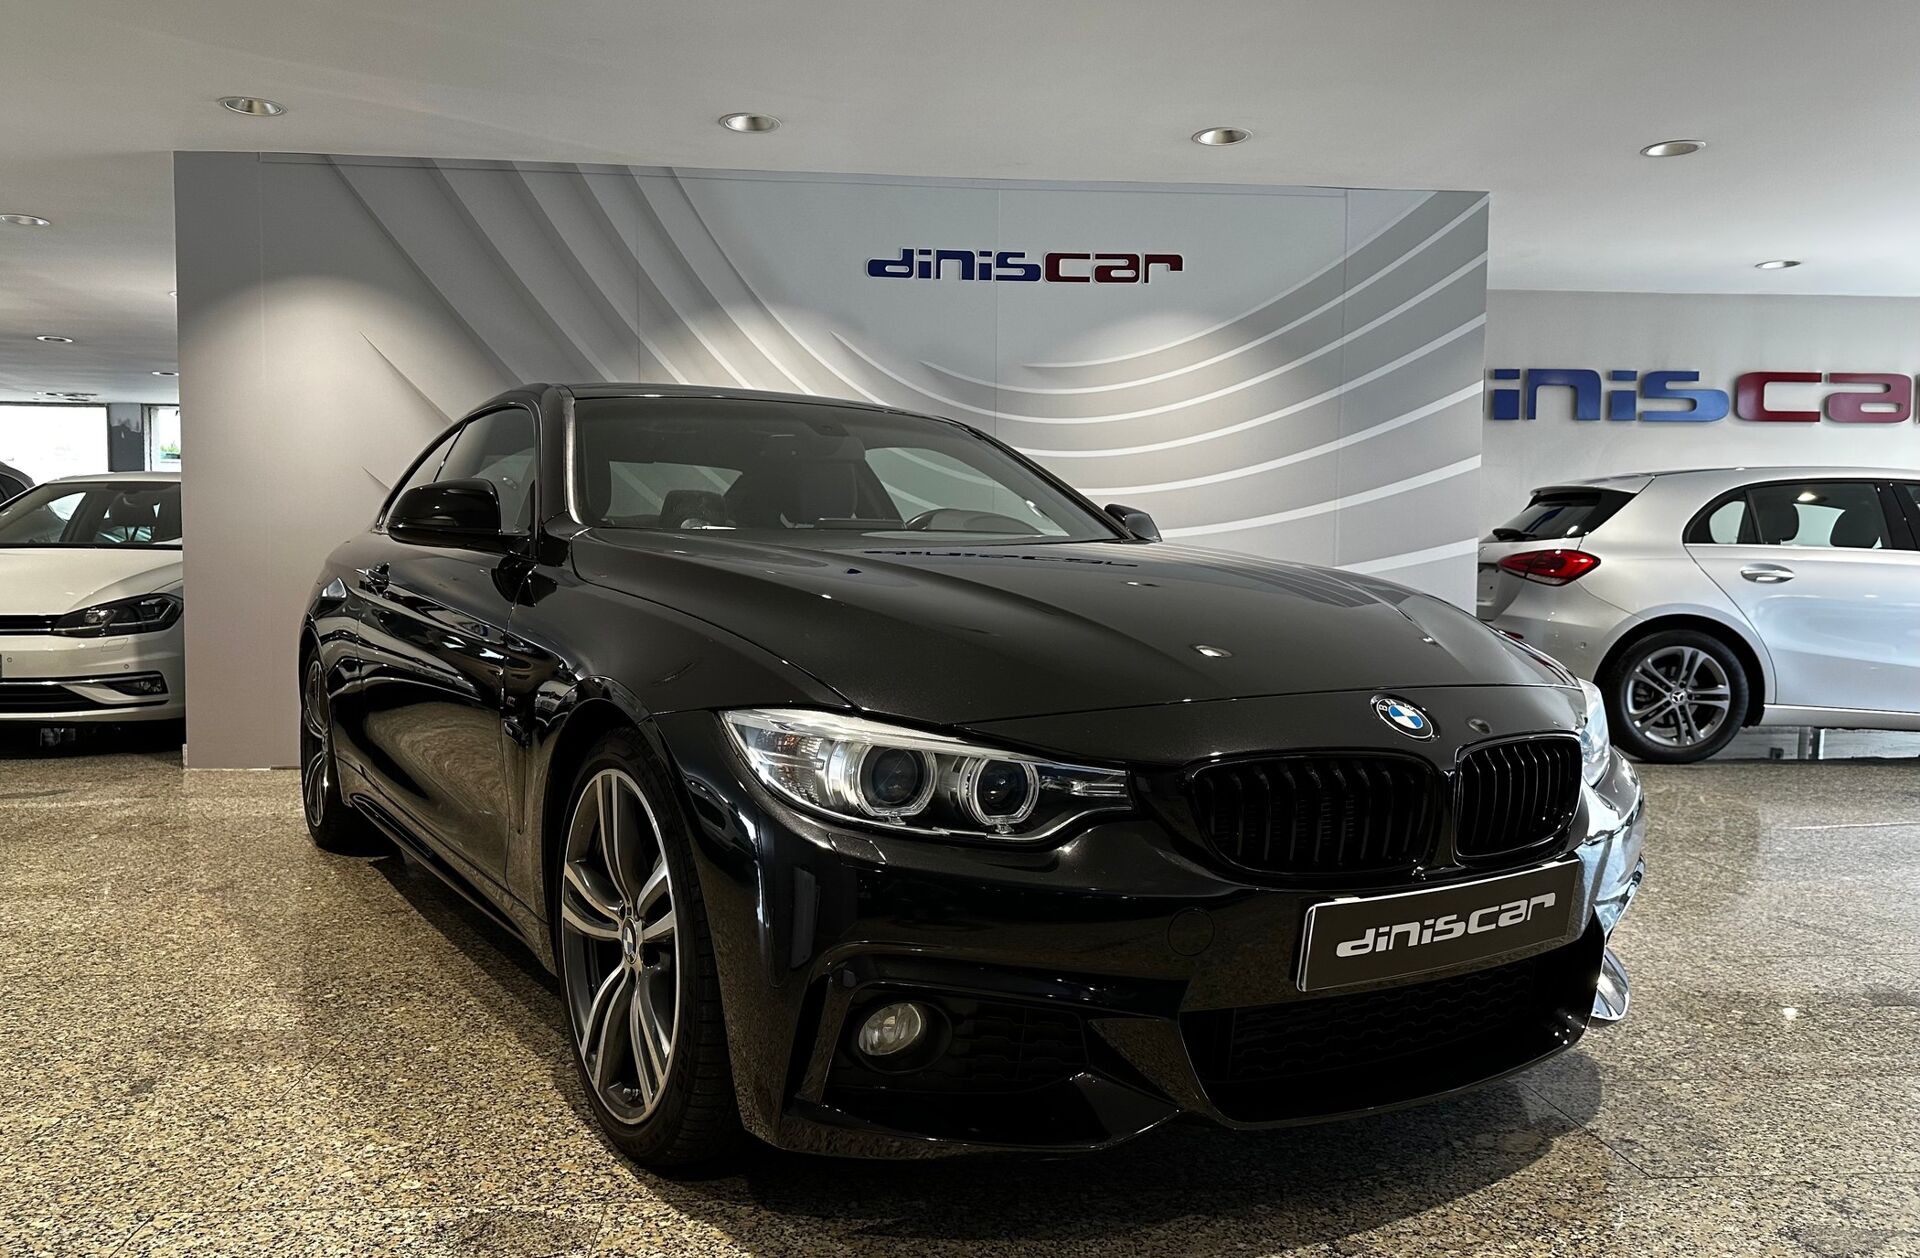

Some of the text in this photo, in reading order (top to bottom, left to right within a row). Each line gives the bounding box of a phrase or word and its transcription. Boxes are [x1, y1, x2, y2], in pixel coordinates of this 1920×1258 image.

[866, 248, 1184, 284] diniscar
[1484, 368, 1920, 424] inisca
[1336, 892, 1556, 957] diniscar
